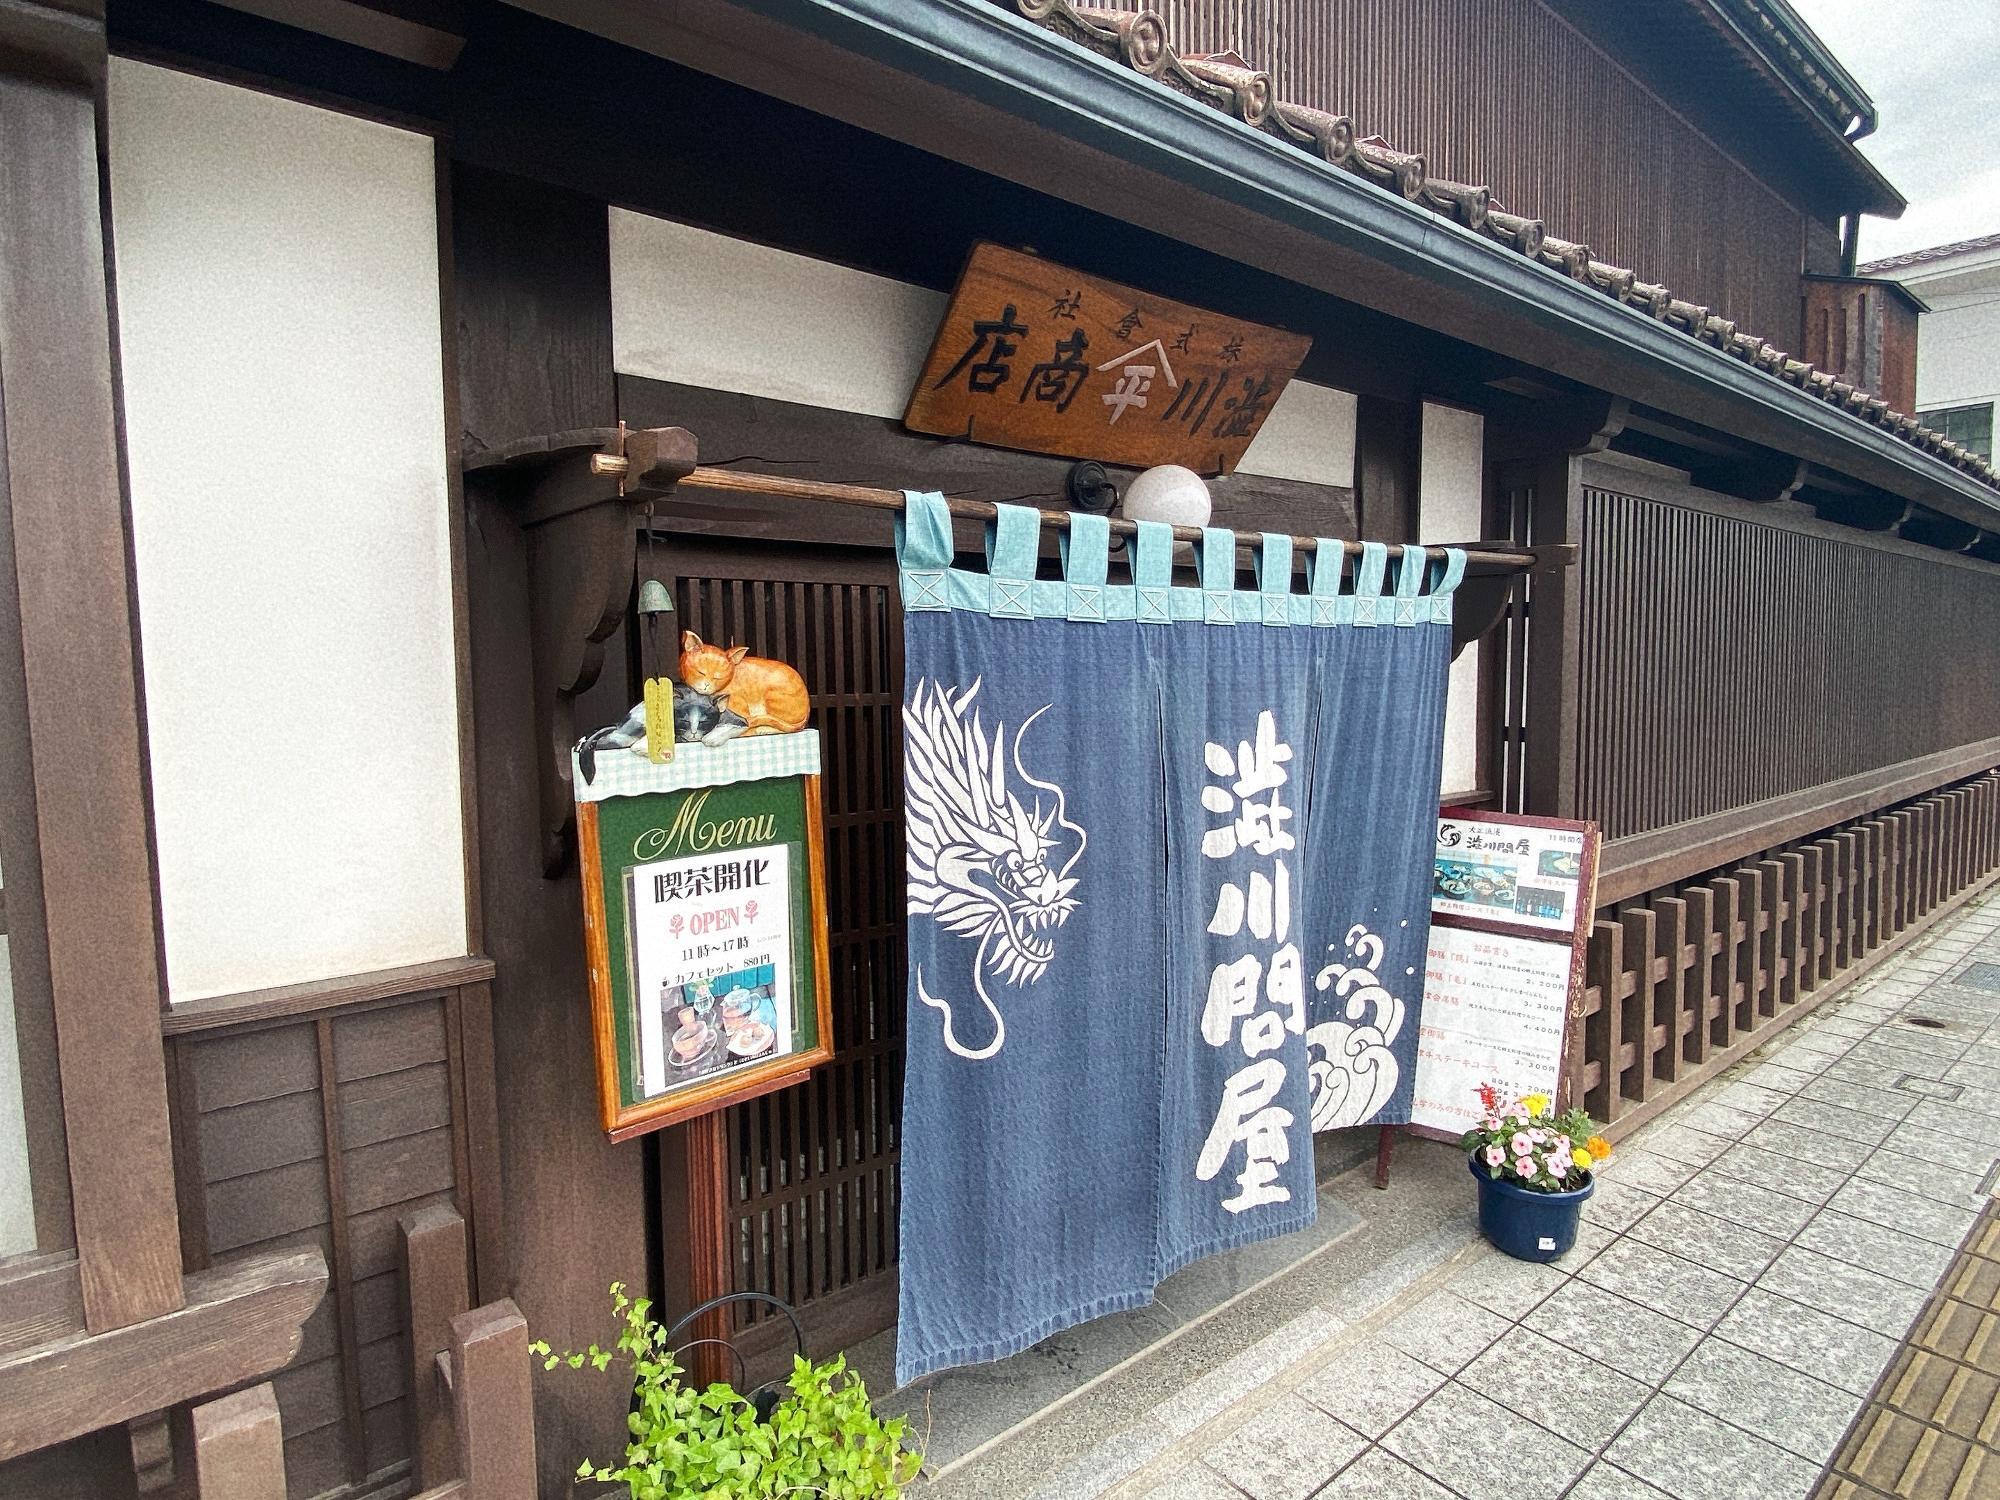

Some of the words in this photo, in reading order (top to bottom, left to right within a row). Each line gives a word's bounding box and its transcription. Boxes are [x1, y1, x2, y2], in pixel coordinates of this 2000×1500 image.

[633, 789, 778, 861] Menu
[653, 858, 772, 904] 喫茶開化
[689, 906, 740, 936] OPEN
[675, 963, 734, 984] カフェセット
